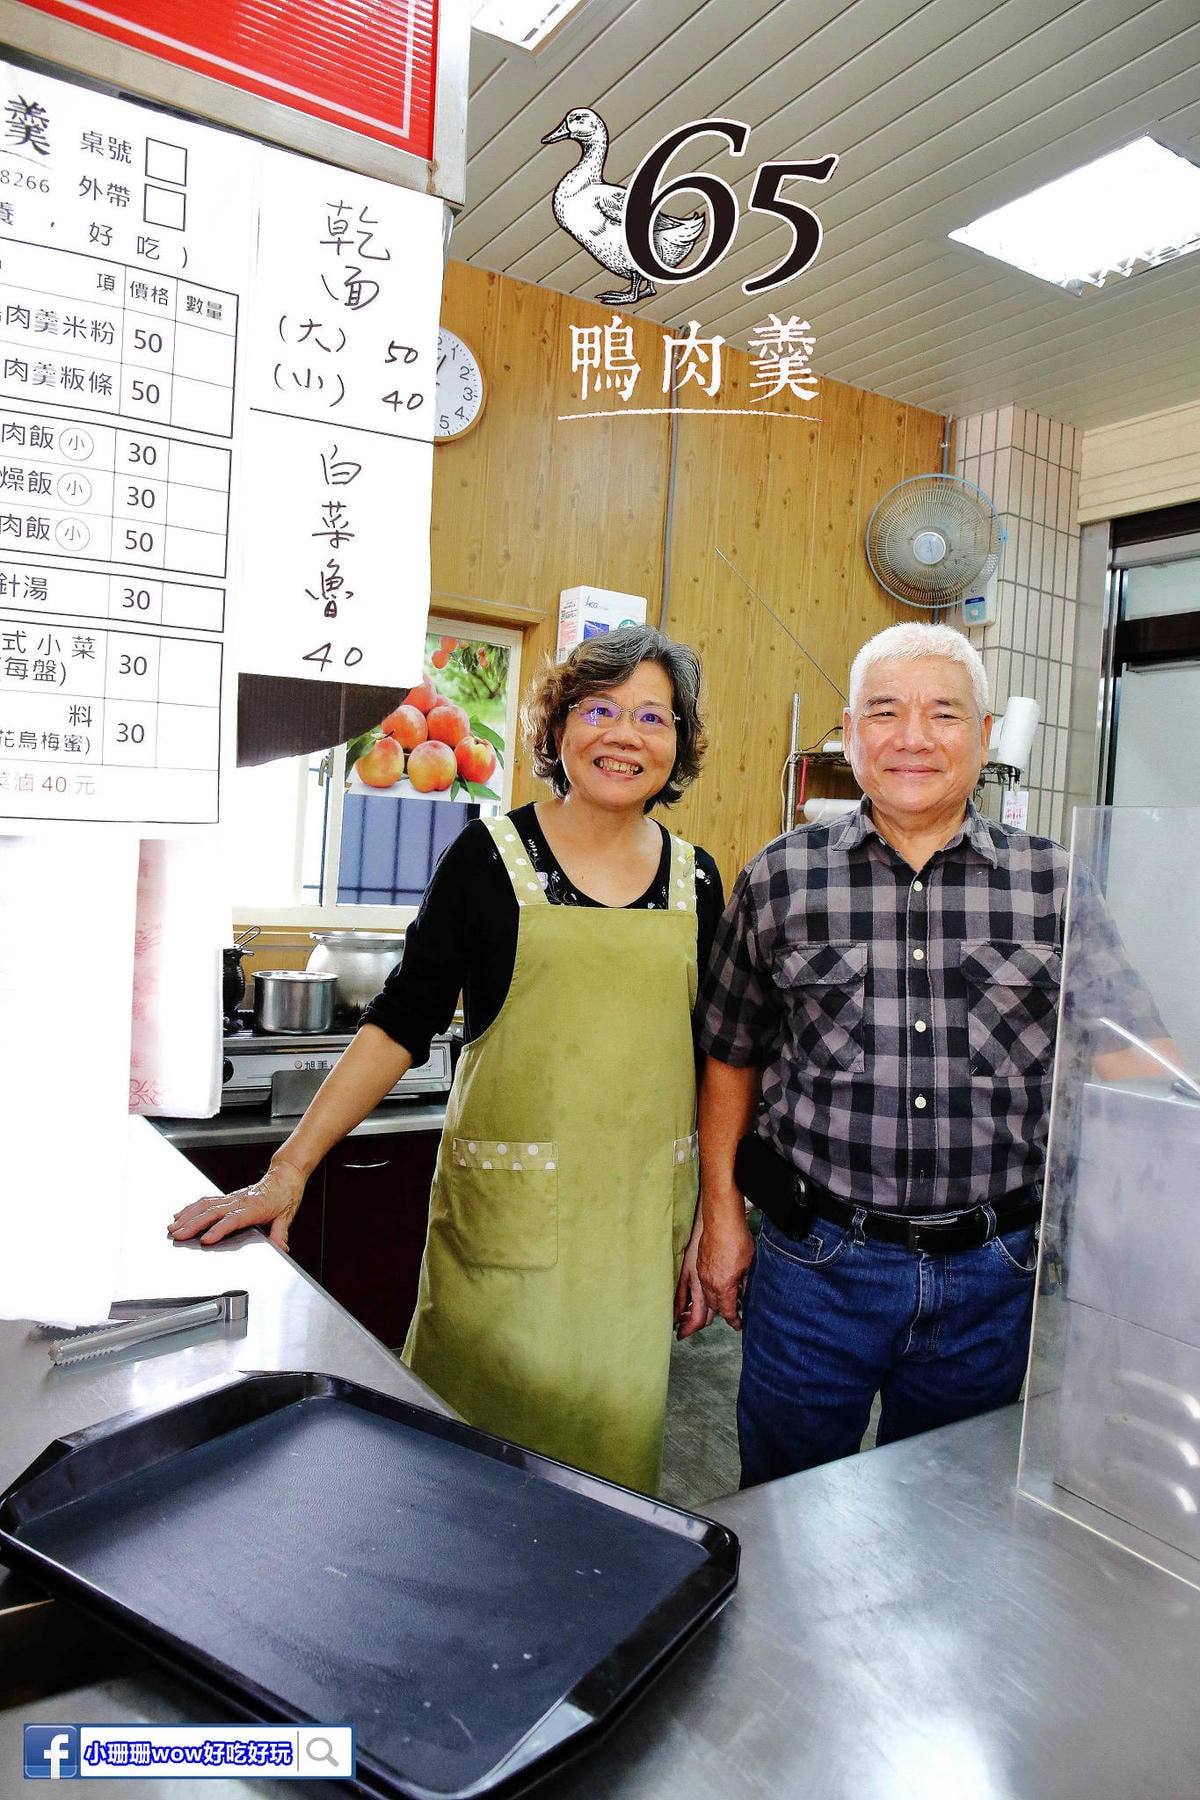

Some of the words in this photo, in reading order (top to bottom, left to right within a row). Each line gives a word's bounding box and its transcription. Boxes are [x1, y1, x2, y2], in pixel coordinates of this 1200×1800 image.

[80, 131, 132, 164] 桌號
[0, 169, 50, 194] 8266
[79, 175, 130, 208] 外帶
[96, 273, 116, 293] 項
[129, 280, 169, 306] 價格
[186, 295, 223, 321] 數量
[0, 304, 115, 345] 肉羹米粉
[133, 329, 163, 353] 50
[384, 340, 419, 364] 50
[459, 365, 470, 381] 2
[130, 380, 161, 404] 50
[381, 390, 424, 412] 40
[462, 386, 473, 402] 3
[439, 414, 450, 430] 5
[454, 406, 465, 420] 4
[1, 422, 55, 450] 肉飯
[128, 442, 157, 466] 30
[0, 466, 52, 496] 燥飯
[126, 486, 156, 509] 30
[0, 513, 50, 541] 肉飯
[125, 529, 154, 553] 50
[0, 573, 48, 601] 針湯
[122, 588, 151, 610] 30
[0, 656, 67, 687] 每盤)
[119, 654, 148, 676] 30
[302, 642, 363, 672] 40
[69, 704, 93, 728] 料
[116, 722, 145, 744] 30
[41, 775, 67, 793] 40
[75, 775, 95, 796] 元
